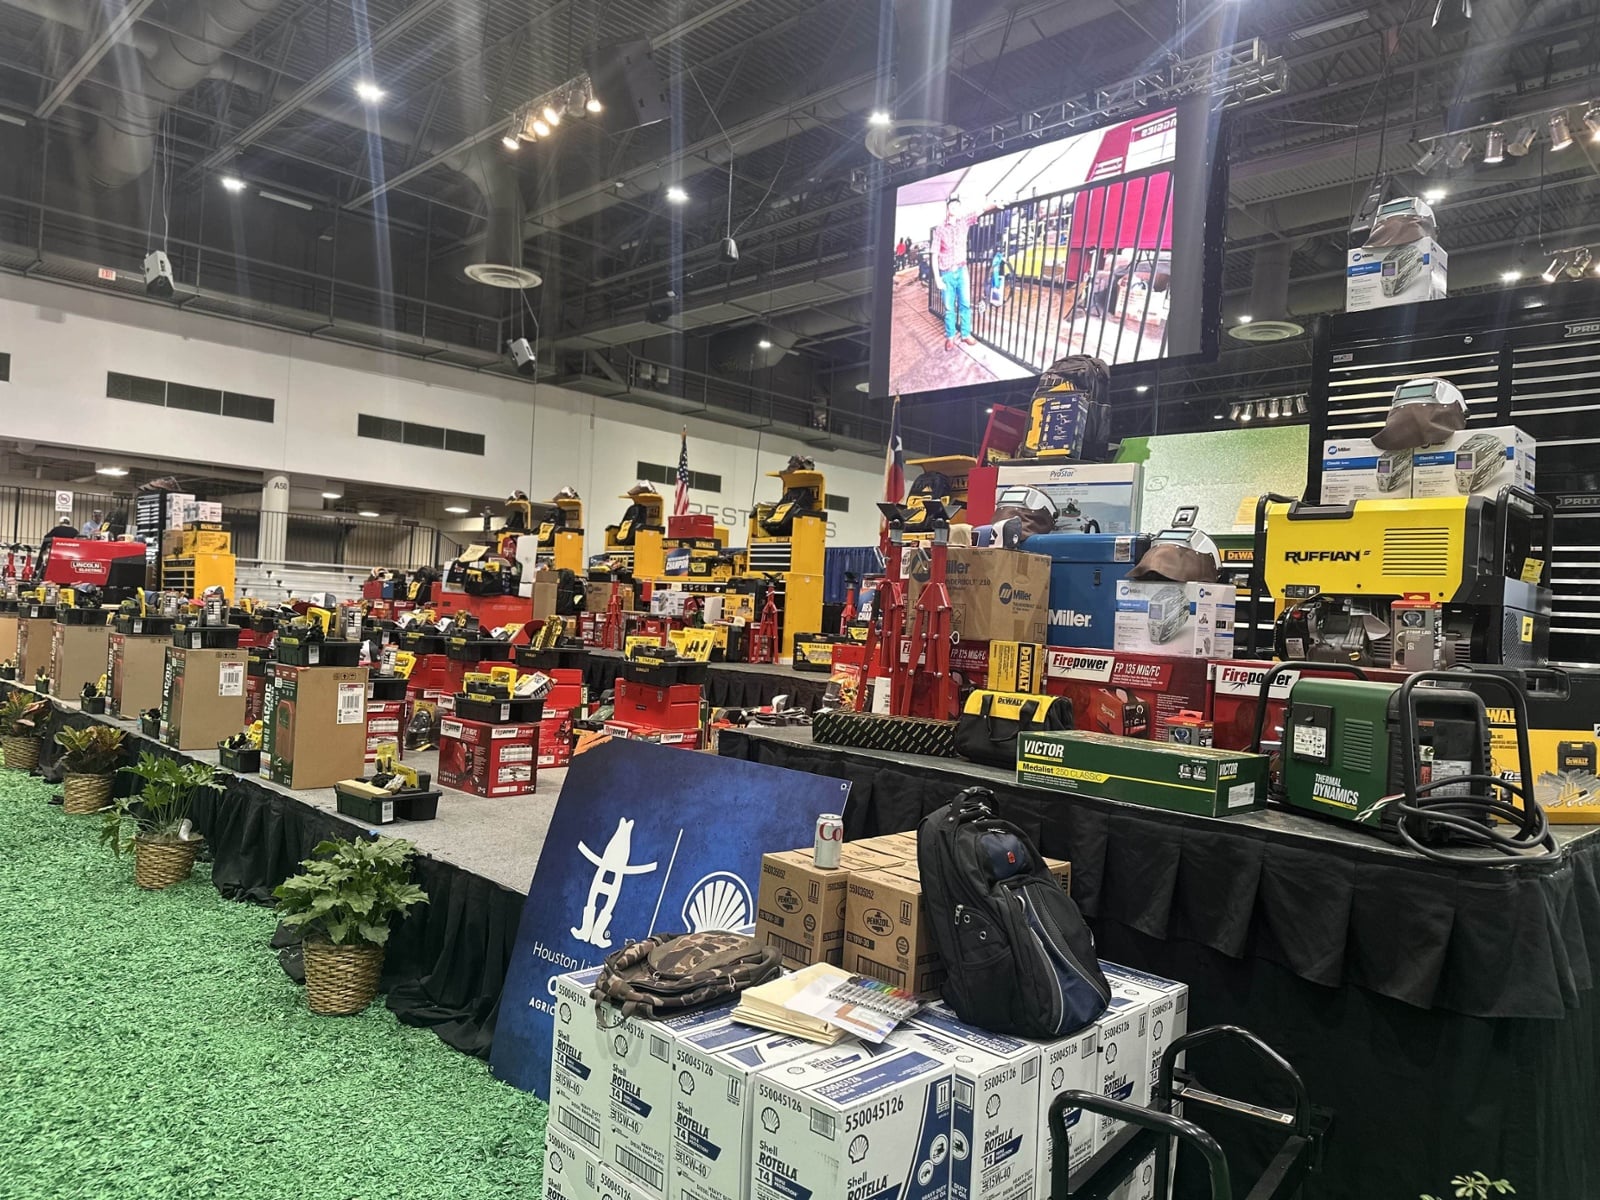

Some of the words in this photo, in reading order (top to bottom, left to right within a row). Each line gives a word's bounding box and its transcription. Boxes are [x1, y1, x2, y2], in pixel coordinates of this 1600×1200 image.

[1049, 470, 1075, 478] ProStar
[1284, 550, 1361, 565] RUFFIAN
[947, 560, 971, 574] iller
[1013, 590, 1032, 601] Miller
[1048, 609, 1092, 627] Miller
[1019, 646, 1032, 692] DEWALT
[1053, 653, 1109, 670] Firepower
[1114, 663, 1124, 673] FP
[1125, 664, 1136, 675] 135
[1136, 664, 1161, 677] MIG/FC
[1222, 667, 1292, 685] Firepoer
[264, 683, 272, 724] AC/DC
[1024, 740, 1064, 758] VICTOR
[1022, 763, 1054, 774] Medalist
[1055, 768, 1069, 777] 250
[1070, 769, 1103, 781] CLASSIC
[1220, 763, 1238, 775] VICTOR
[1503, 771, 1514, 779] 72
[1315, 773, 1341, 787] THERMAL
[1313, 783, 1359, 805] DYNAMICS
[866, 916, 890, 928] PENNZOIL
[532, 941, 578, 970] Houston
[559, 984, 586, 1008] 550045126
[613, 1015, 644, 1040] 55045126
[557, 1040, 582, 1062] ROTELLA
[612, 1063, 627, 1076] Shell
[677, 1050, 714, 1077] 550045126
[612, 1074, 641, 1099] ROTELLA
[984, 1067, 1017, 1092] 550045126
[611, 1086, 621, 1100] T4
[759, 1084, 802, 1113] 550045126
[677, 1101, 693, 1117] Shell
[845, 1095, 904, 1133] 550045126
[616, 1111, 639, 1134] 15W-40
[676, 1112, 709, 1139] ROTELLA
[676, 1127, 687, 1140] T4
[984, 1125, 999, 1140] Shell
[984, 1127, 1014, 1154] ROTELLA
[548, 1133, 576, 1160] 550045126
[759, 1140, 778, 1157] Shell
[682, 1154, 707, 1178] 15W-40
[759, 1152, 799, 1181] ROTELLA
[984, 1155, 993, 1168] T4
[758, 1168, 770, 1182] T4
[847, 1171, 867, 1189] Shell
[989, 1166, 1011, 1189] 15W-40
[600, 1173, 631, 1200] 550045126
[847, 1175, 889, 1200] ROTELLA
